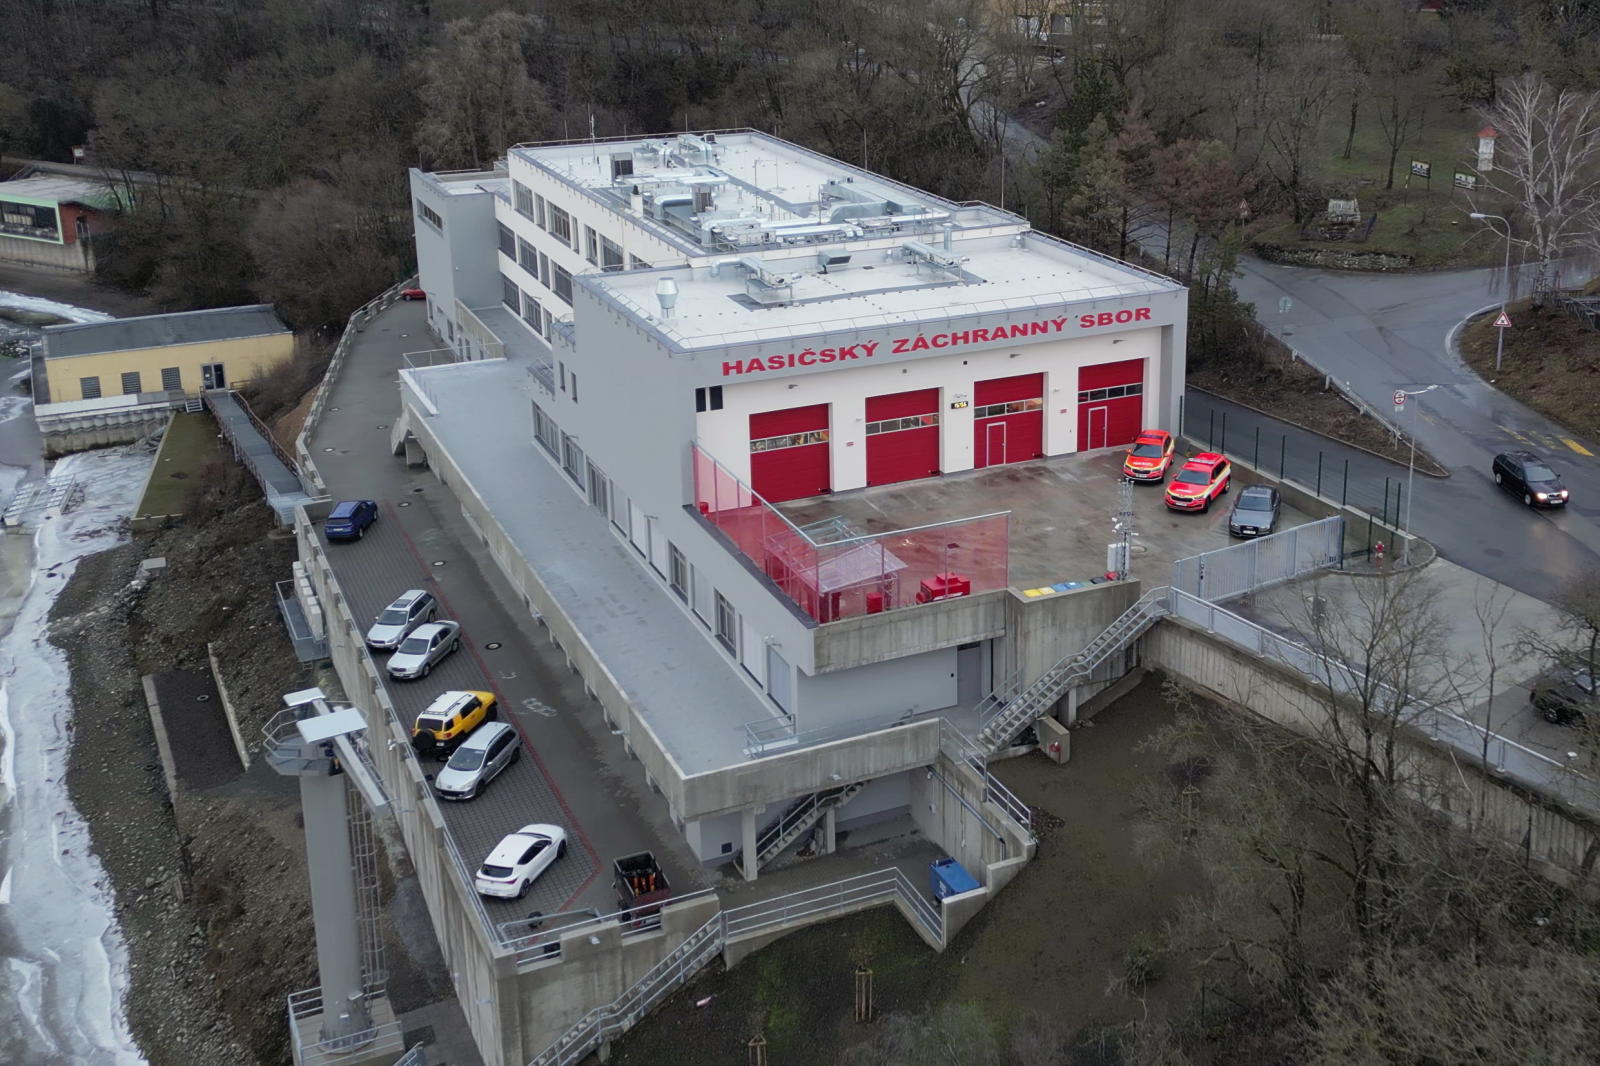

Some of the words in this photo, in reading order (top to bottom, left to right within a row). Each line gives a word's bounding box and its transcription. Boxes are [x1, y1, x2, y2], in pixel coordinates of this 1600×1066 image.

[722, 340, 880, 377] HASIČSKÝ
[891, 315, 1069, 354] ZÁCHRANNÝ
[1079, 307, 1152, 329] SBOR
